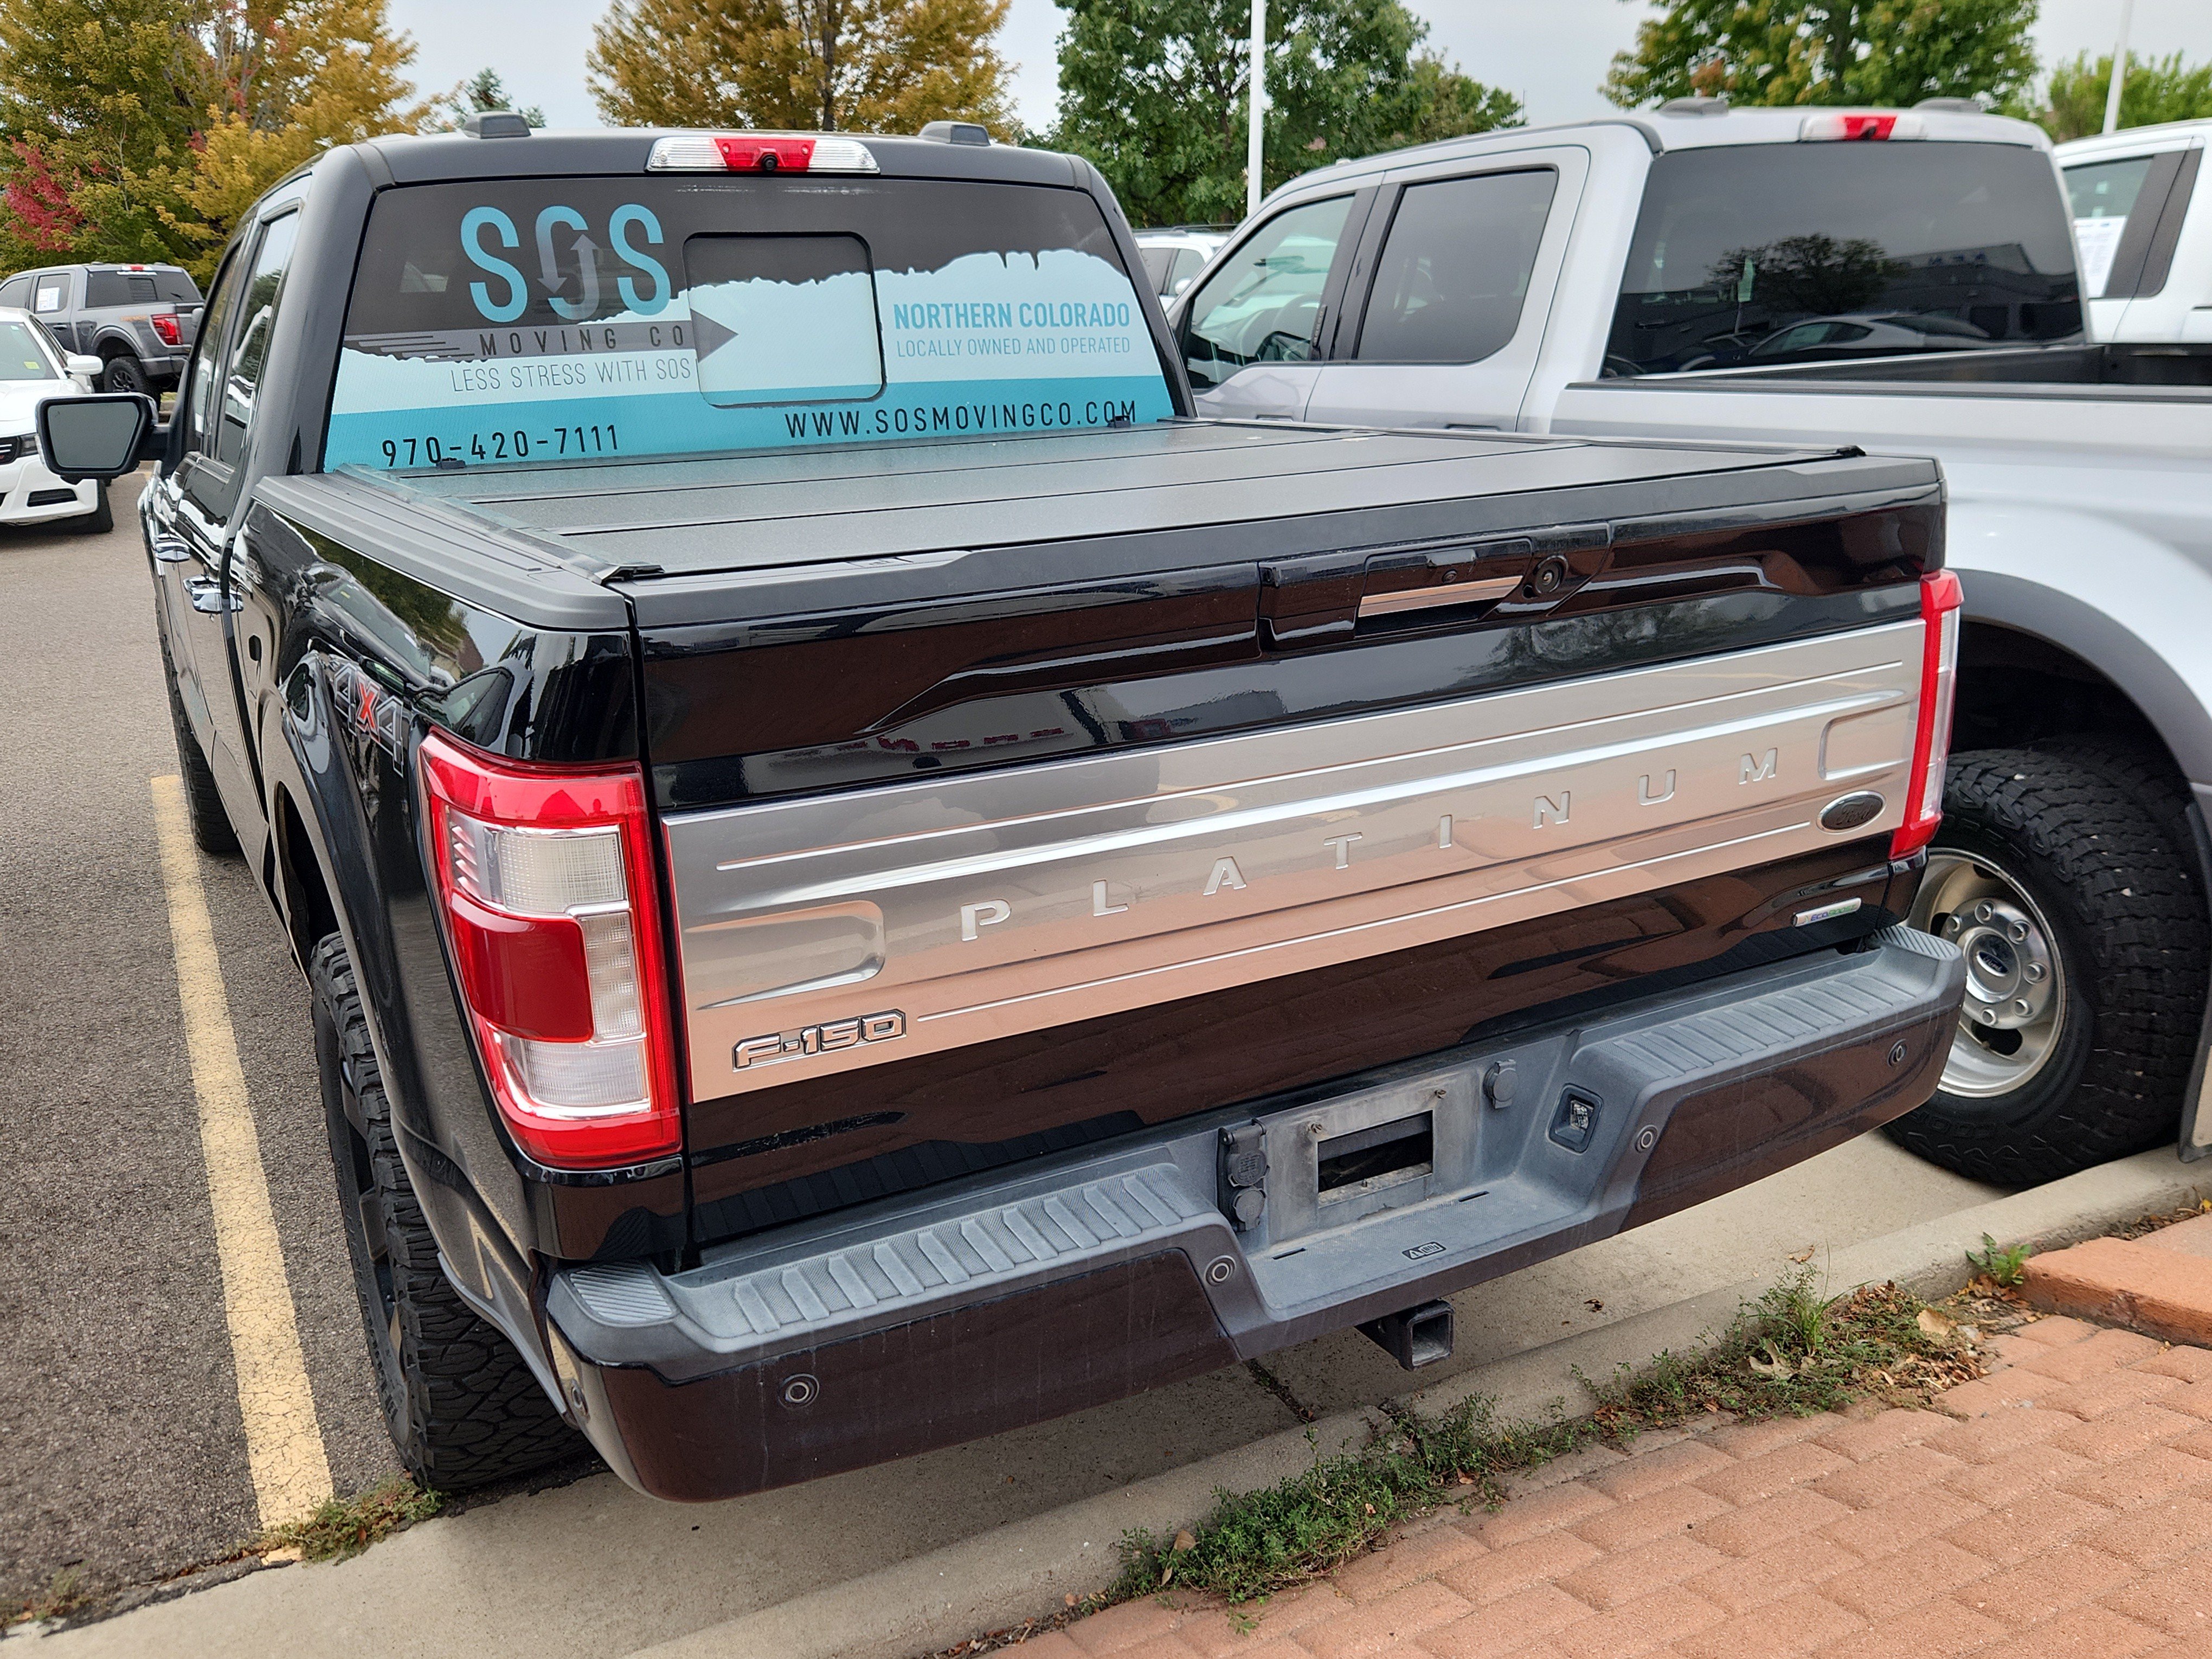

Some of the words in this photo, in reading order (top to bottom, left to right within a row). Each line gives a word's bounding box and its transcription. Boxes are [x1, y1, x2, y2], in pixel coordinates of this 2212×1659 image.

[460, 203, 671, 323] SOS
[893, 303, 1012, 330] NORTHERN
[1019, 302, 1130, 328] COLORADO
[479, 328, 617, 356] MOVING
[650, 325, 685, 346] CO
[896, 338, 963, 358] LOCALLY
[968, 337, 1021, 356] OWNED
[1026, 337, 1056, 355] AND
[1060, 336, 1130, 354] OPERATED
[451, 368, 501, 393] LESS
[511, 362, 587, 389] STRESS
[594, 359, 647, 383] WITH
[655, 358, 691, 380] SOS
[785, 400, 1136, 438] WWW.SOSMOVINGCO.COM
[382, 424, 619, 468] 970-420-7111
[960, 747, 1778, 942] PLATINUM
[732, 1008, 907, 1072] F-150
